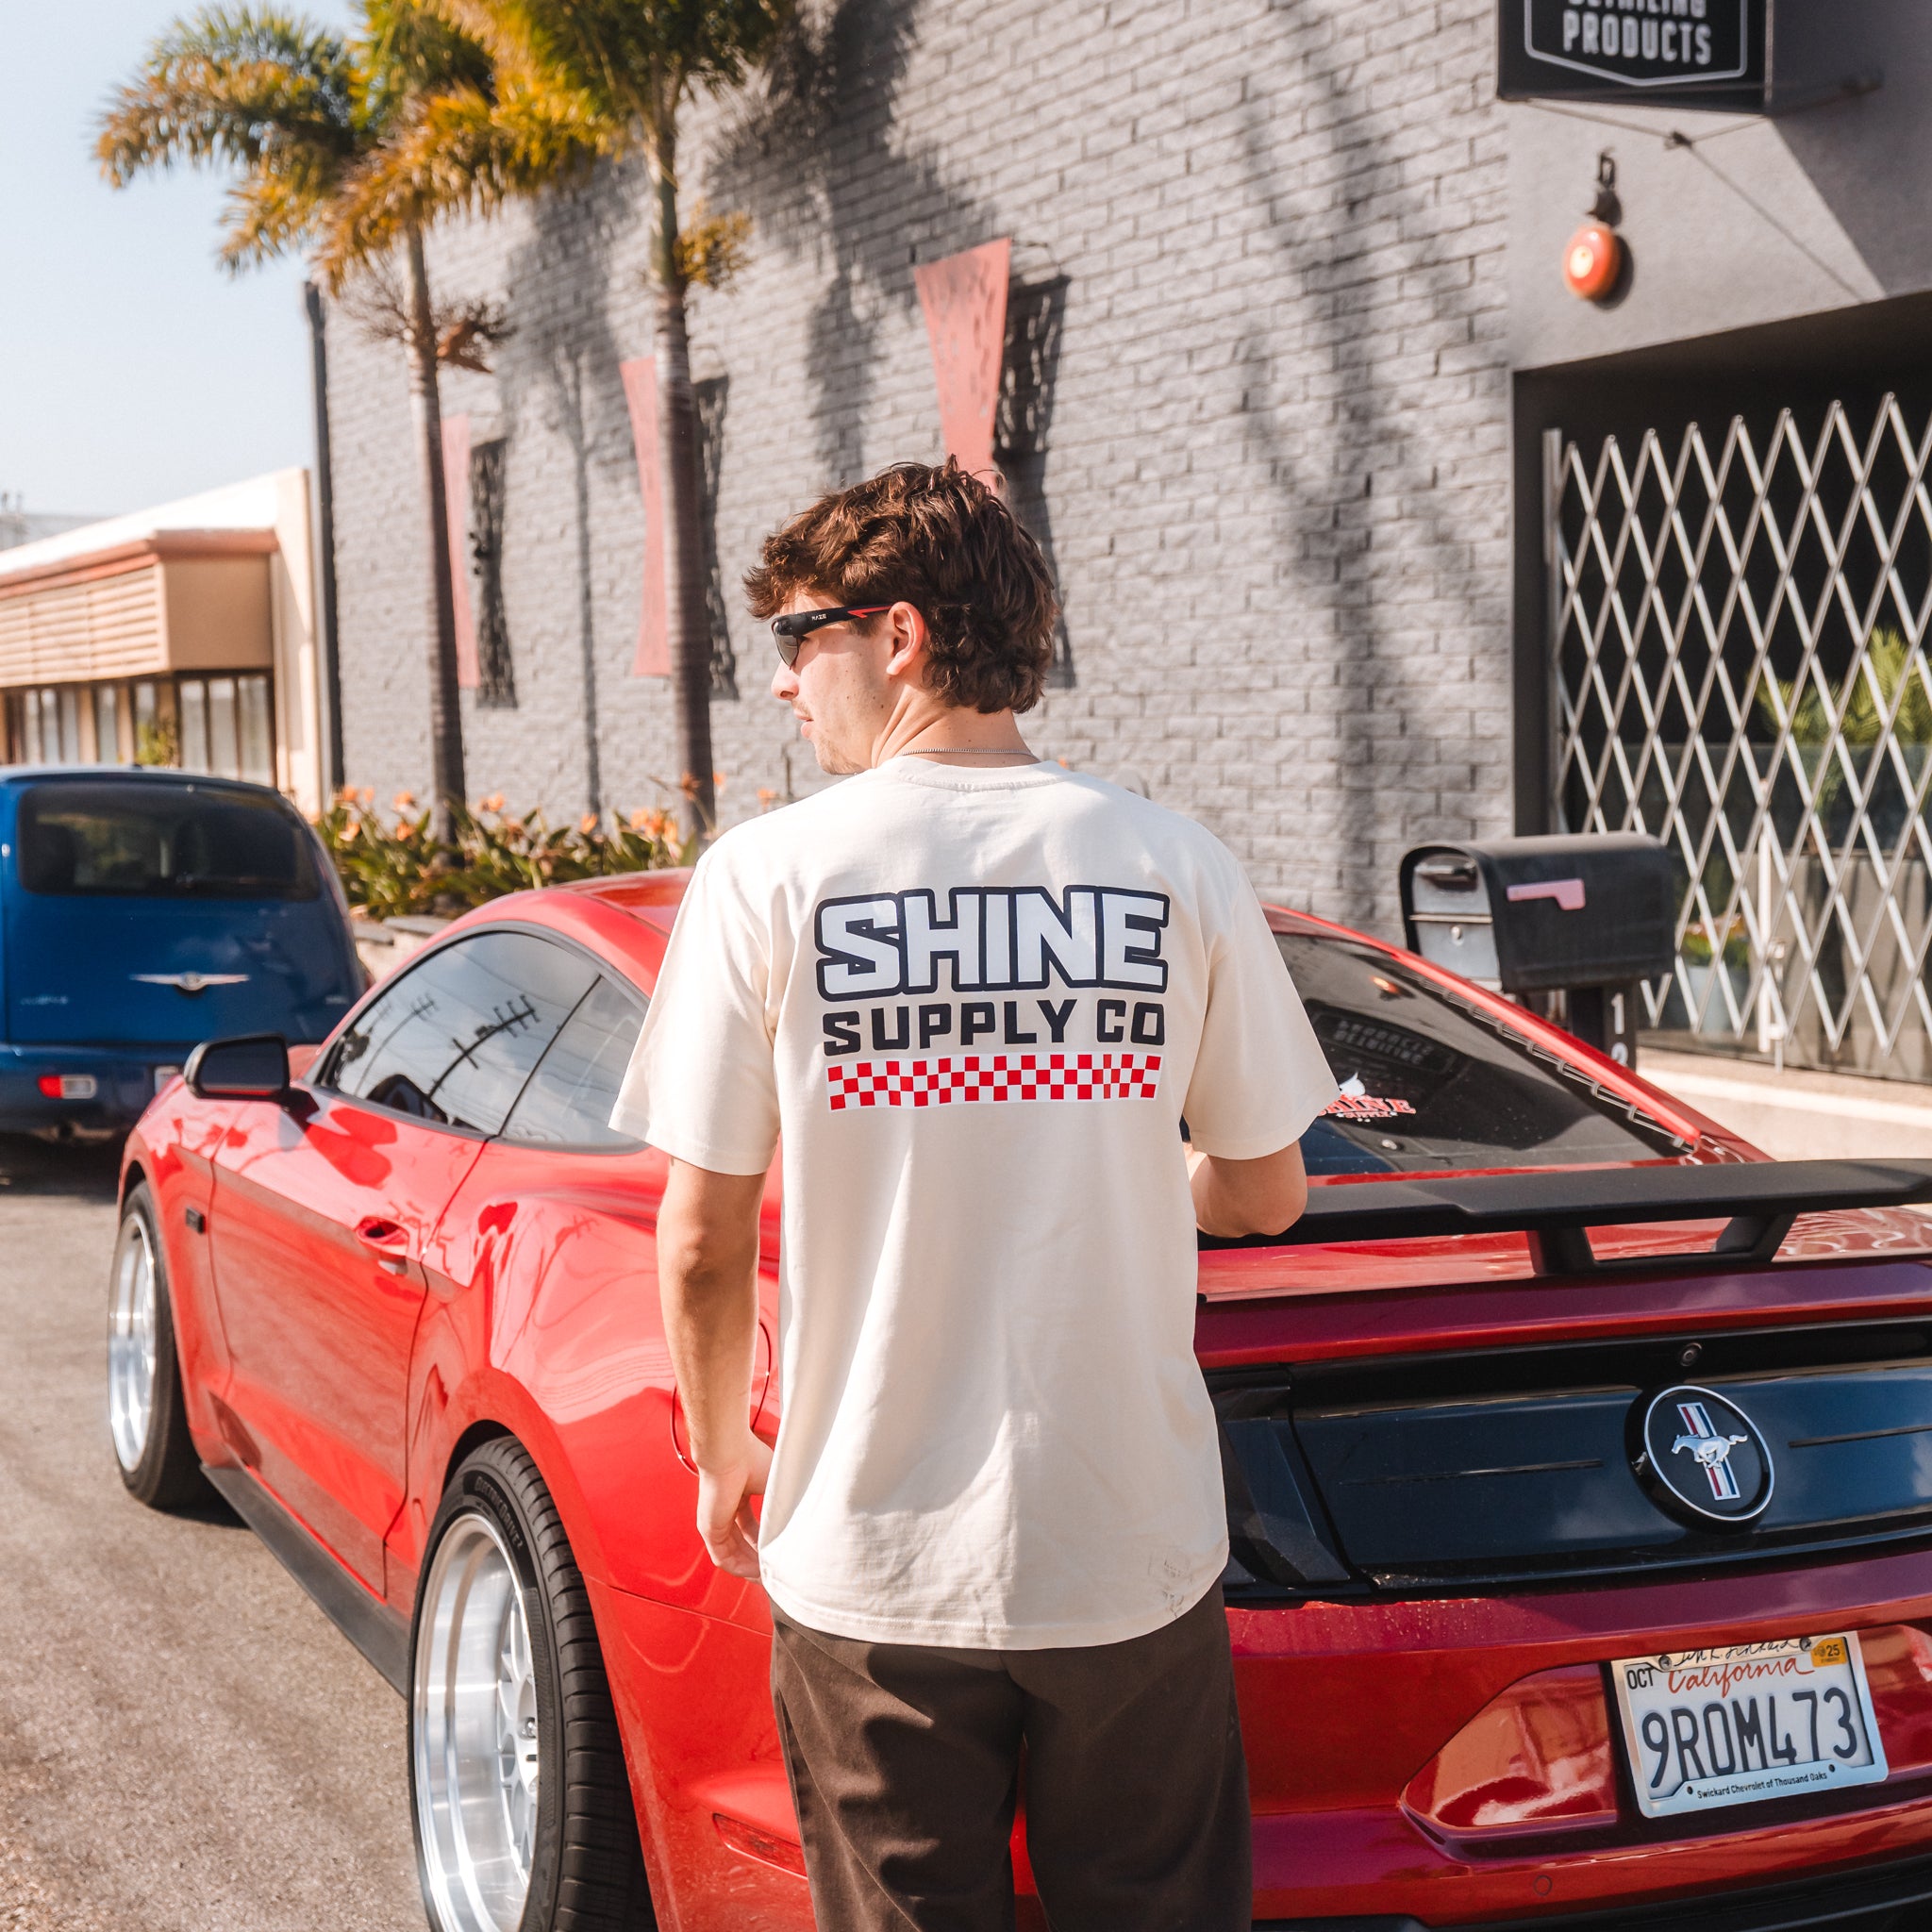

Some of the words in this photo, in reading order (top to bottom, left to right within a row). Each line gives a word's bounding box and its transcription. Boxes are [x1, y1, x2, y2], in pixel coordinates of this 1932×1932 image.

[1562, 9, 1711, 65] PRODUCTS
[814, 885, 1171, 1002] SHINE
[823, 999, 1077, 1056] SUPPLY
[1096, 999, 1165, 1045] CO
[1825, 1643, 1840, 1657] 25
[1626, 1667, 1655, 1690] OCT
[1668, 1657, 1815, 1698] California
[1696, 1785, 1730, 1799] Swickard
[1730, 1780, 1765, 1794] Chevrolet
[1766, 1779, 1774, 1789] of
[1774, 1774, 1808, 1788] Thousand
[1809, 1772, 1827, 1781] Oaks
